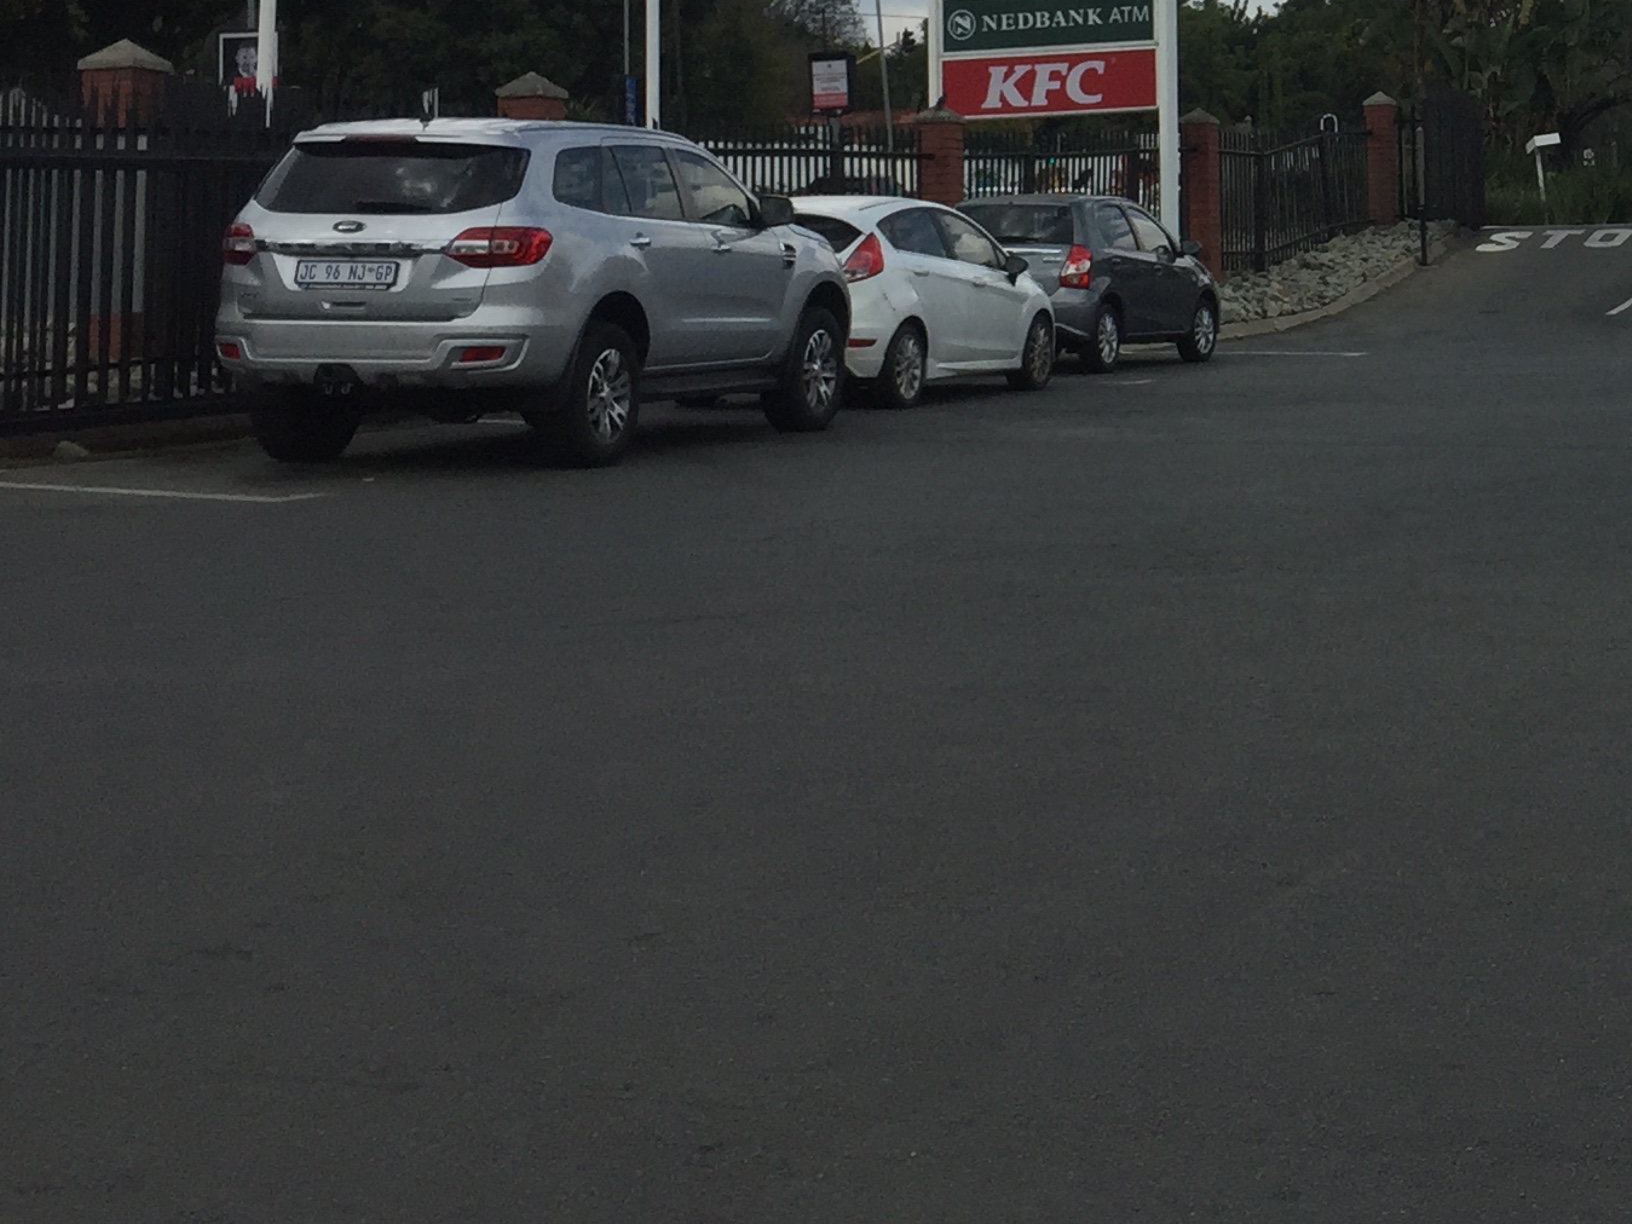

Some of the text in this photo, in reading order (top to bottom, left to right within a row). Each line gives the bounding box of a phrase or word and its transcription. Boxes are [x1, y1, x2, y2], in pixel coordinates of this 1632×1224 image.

[981, 5, 1149, 32] NEDBANK ATM
[980, 60, 1106, 110] KFC
[325, 264, 340, 280] 96
[375, 265, 393, 281] GP
